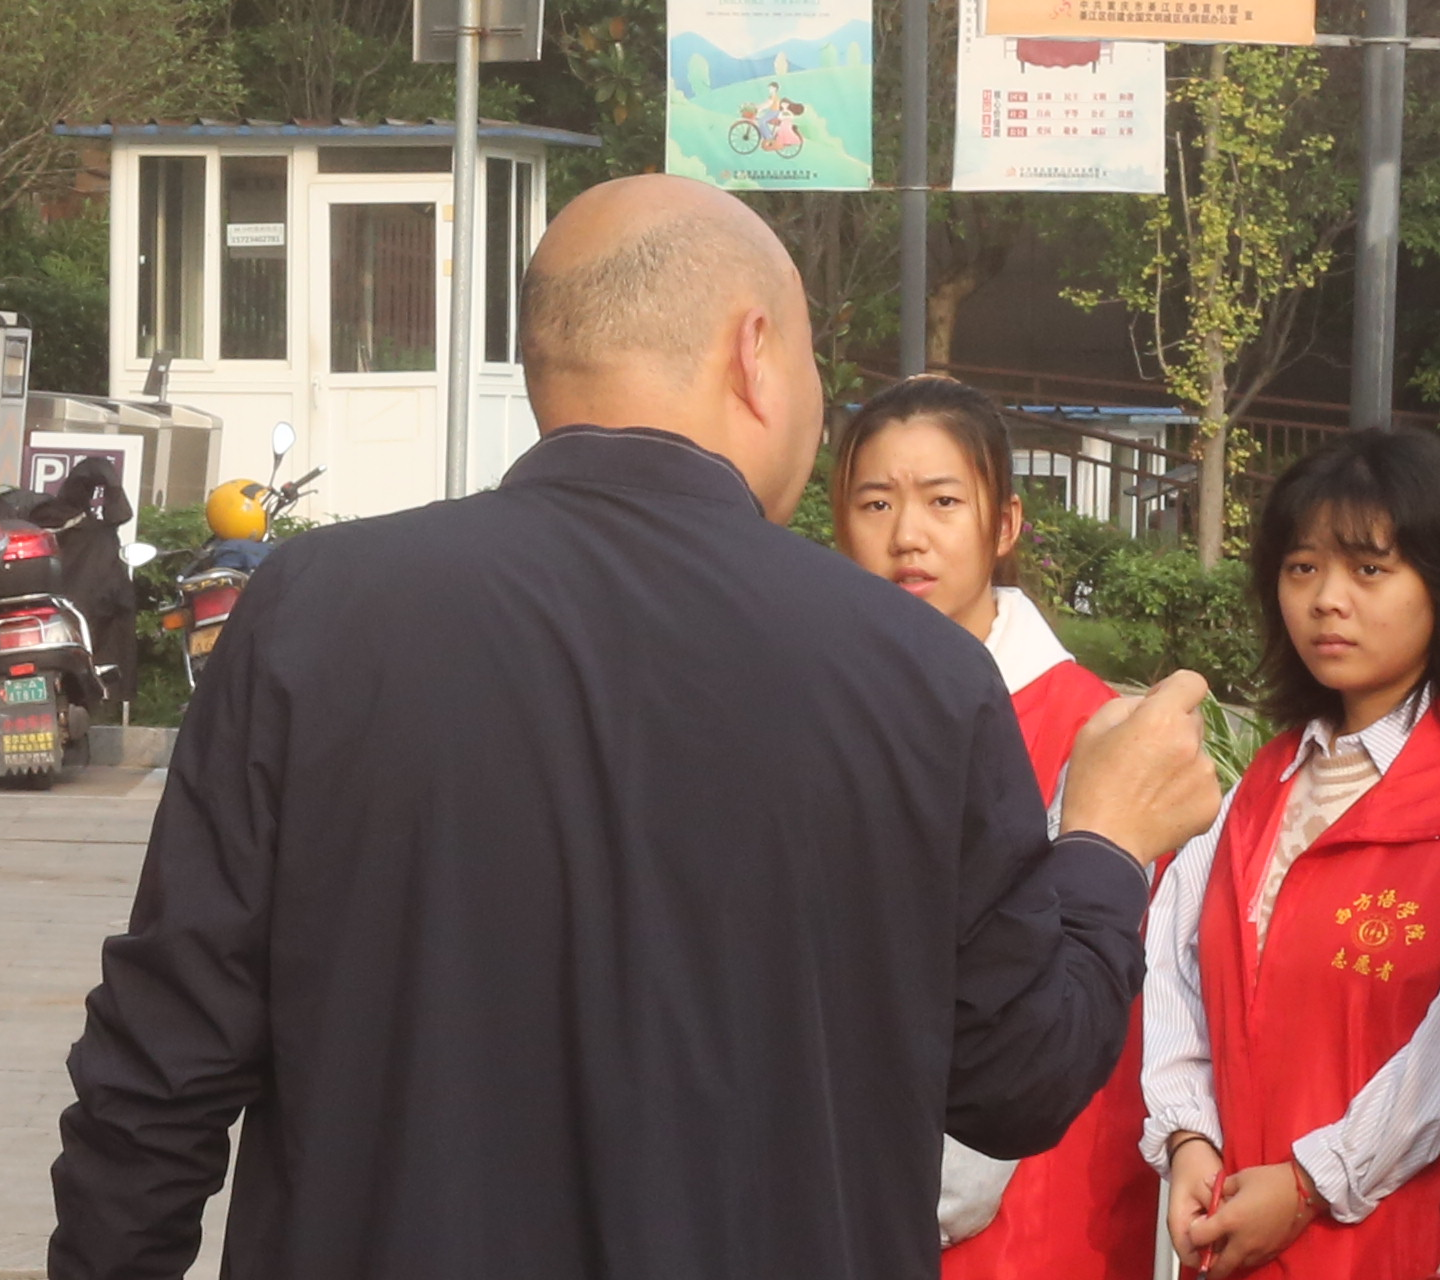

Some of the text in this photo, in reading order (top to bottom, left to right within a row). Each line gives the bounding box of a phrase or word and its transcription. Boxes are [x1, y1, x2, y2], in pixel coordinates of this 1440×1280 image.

[35, 458, 64, 493] P
[1331, 947, 1394, 982] 志愿者
